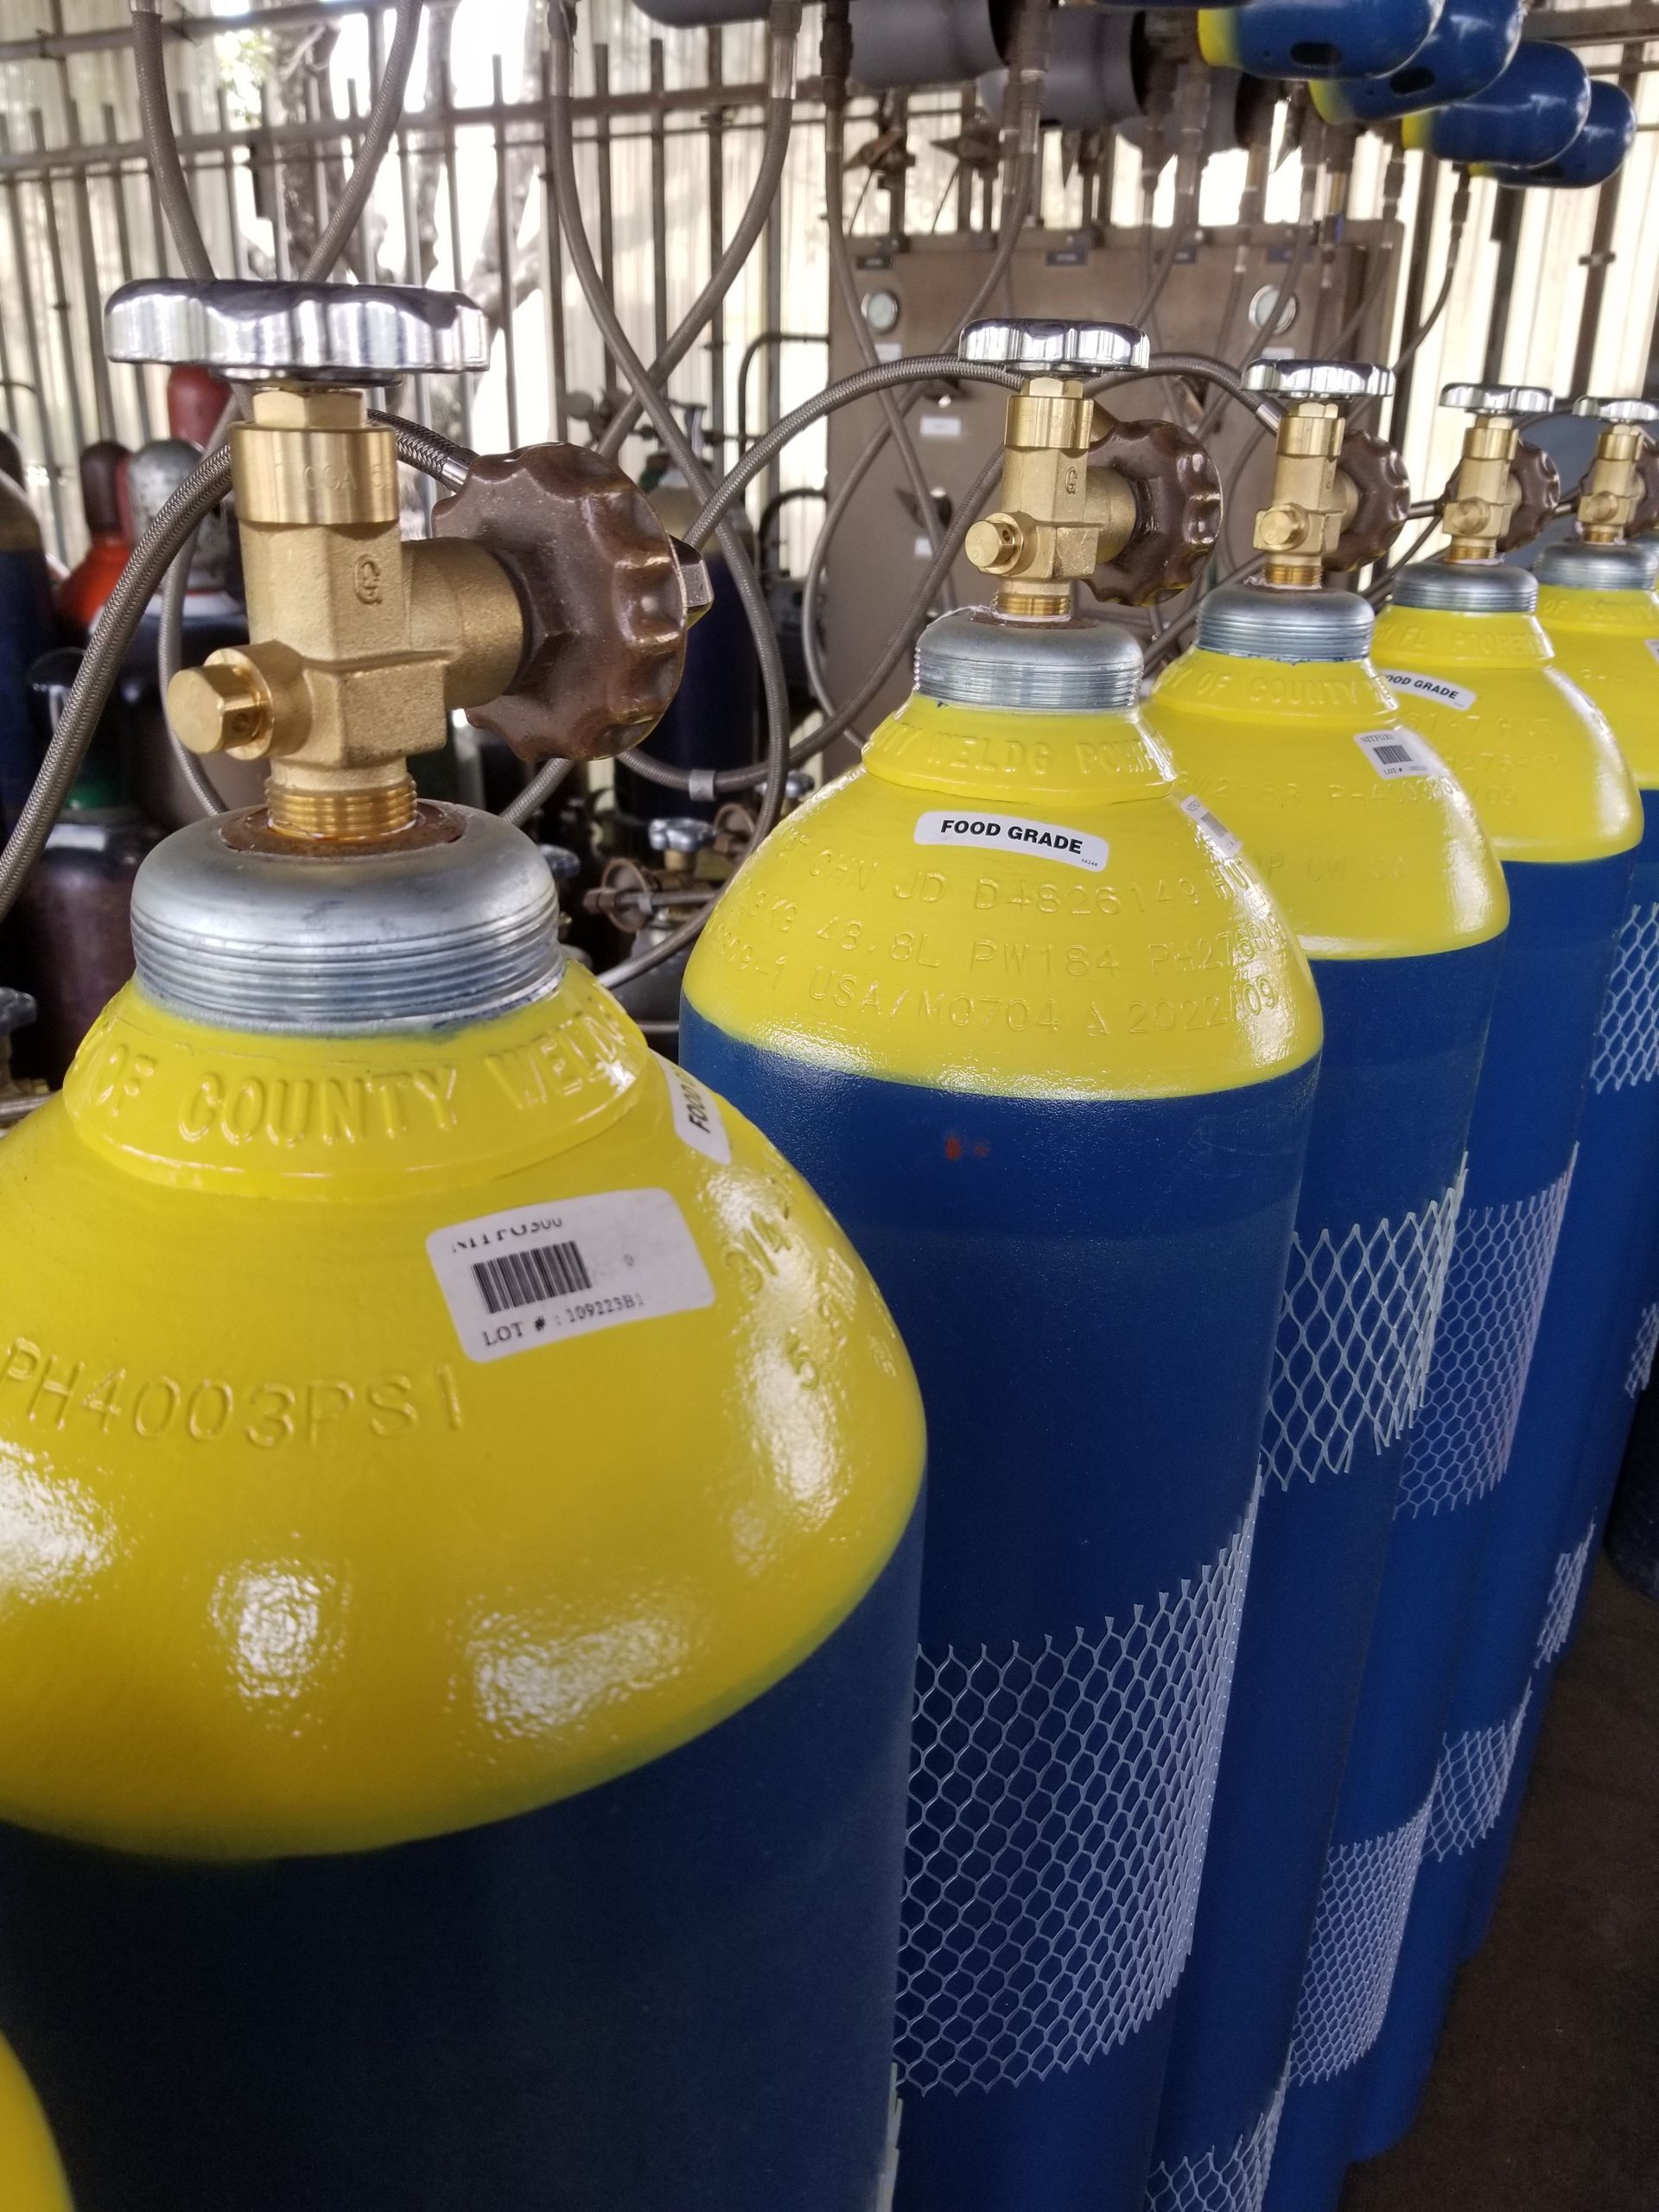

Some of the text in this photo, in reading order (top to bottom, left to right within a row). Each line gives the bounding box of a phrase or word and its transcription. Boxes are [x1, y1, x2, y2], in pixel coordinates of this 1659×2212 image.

[1414, 678, 1459, 701] GRADE
[941, 819, 1084, 855] FOOD GRADE
[177, 1069, 457, 1147] COUNTY
[482, 1320, 524, 1347] LOT
[533, 1315, 546, 1332] #
[0, 1336, 463, 1449] PH4003PSI
